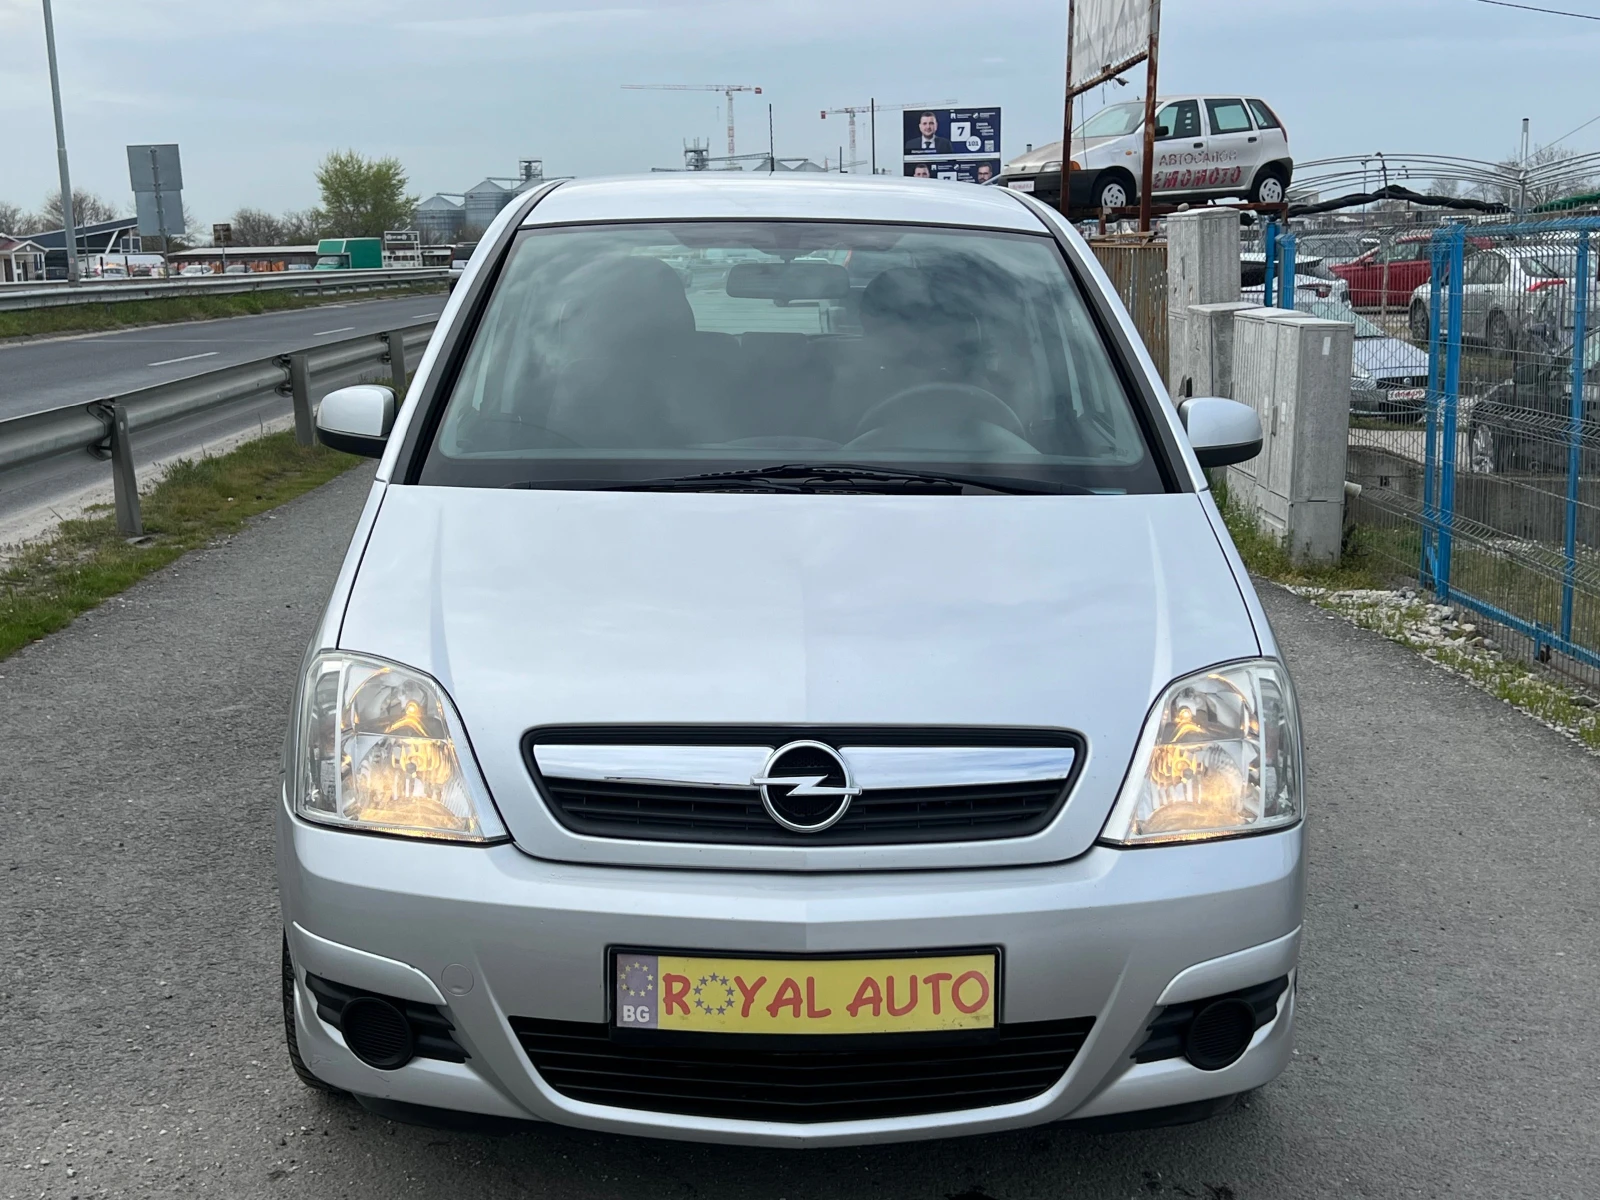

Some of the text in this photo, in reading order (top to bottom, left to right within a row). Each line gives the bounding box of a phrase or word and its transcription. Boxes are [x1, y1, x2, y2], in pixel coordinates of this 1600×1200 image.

[957, 127, 965, 136] 7
[662, 970, 990, 1019] ROYAL AUTO
[622, 1005, 650, 1023] BG
